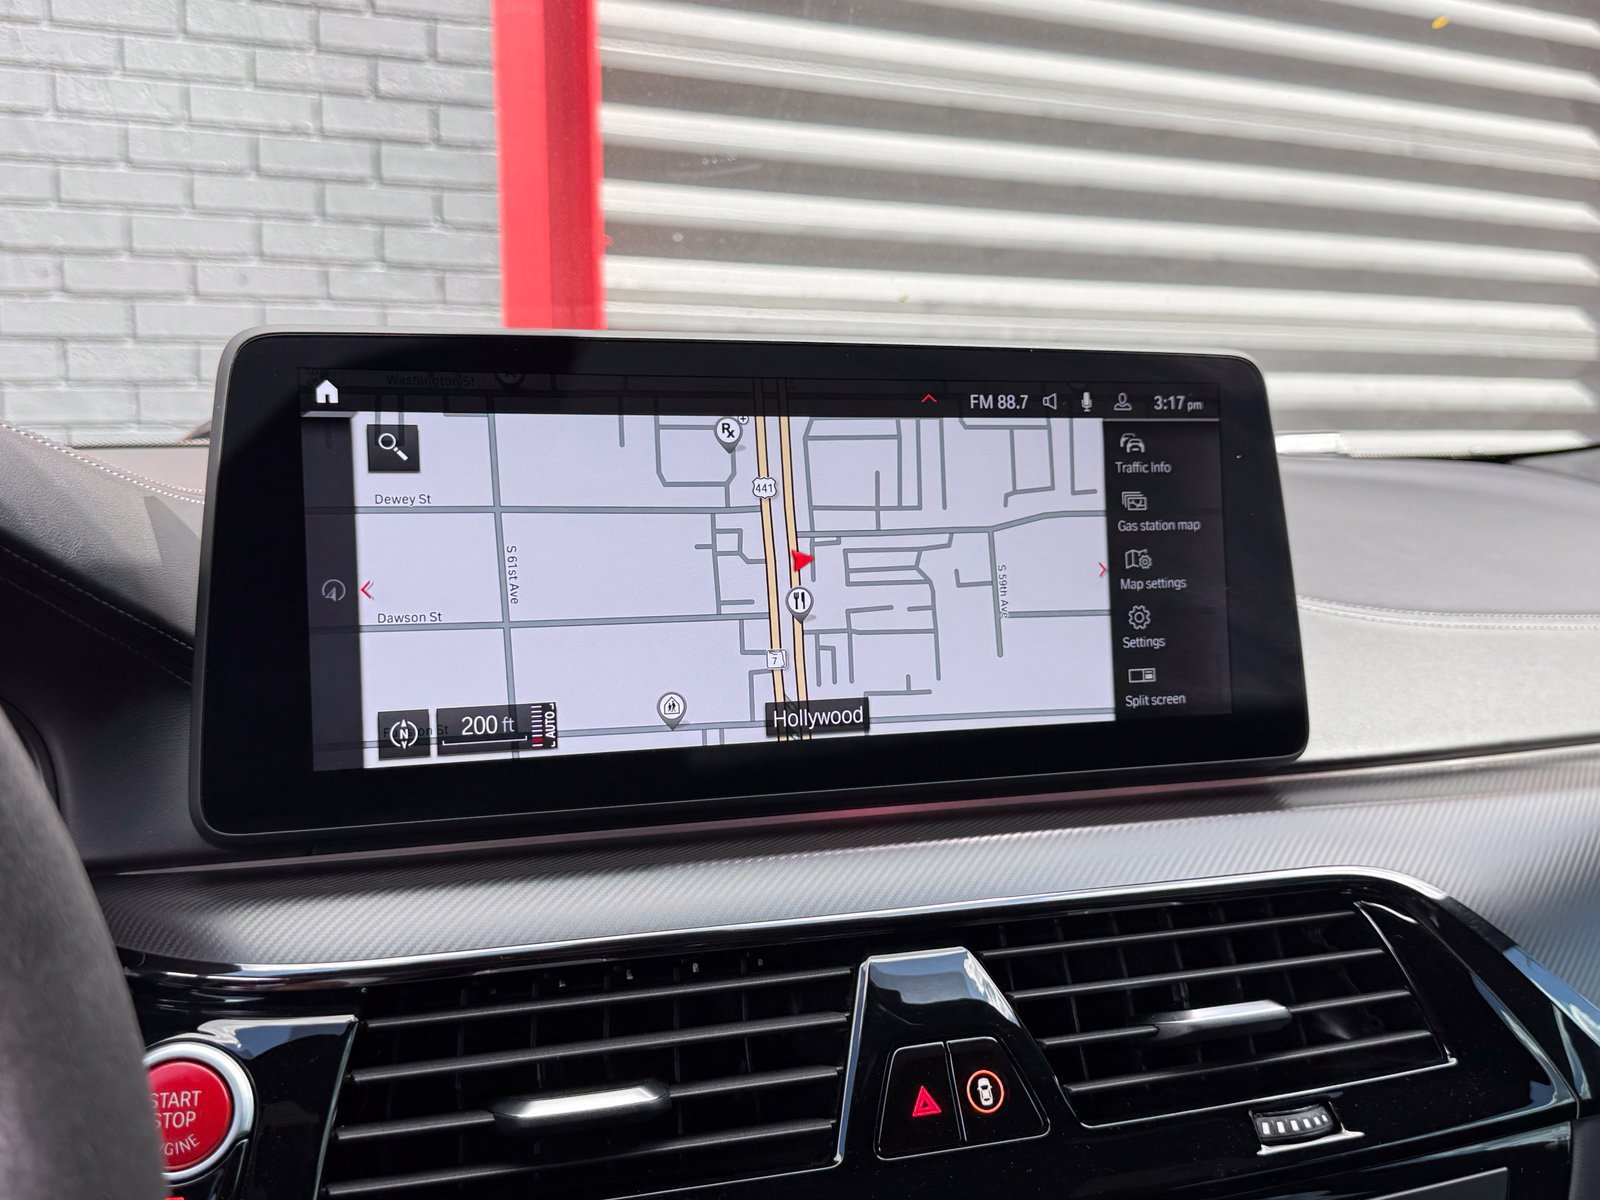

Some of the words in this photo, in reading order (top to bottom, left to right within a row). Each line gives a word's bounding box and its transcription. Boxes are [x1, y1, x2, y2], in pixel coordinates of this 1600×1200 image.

[969, 394, 993, 410] FM
[997, 394, 1029, 410] 88.7
[1153, 395, 1185, 410] 3:17
[1187, 401, 1204, 412] pm
[1115, 461, 1149, 474] Traffic
[1150, 461, 1172, 474] Info
[755, 483, 773, 493] 441
[374, 494, 416, 507] Dewey
[419, 493, 431, 505] St
[1117, 520, 1139, 532] Gas
[1141, 520, 1176, 532] station
[1178, 521, 1201, 534] map
[506, 545, 517, 553] S
[507, 556, 518, 581] 61st
[997, 564, 1007, 572] S
[998, 574, 1008, 597] 59th
[1120, 578, 1143, 591] Map
[1145, 577, 1188, 591] settings
[509, 583, 519, 605] Ave
[1000, 599, 1009, 619] Ave
[377, 612, 426, 623] Dawson
[429, 611, 442, 623] St
[1122, 636, 1166, 650] Settings
[771, 657, 778, 665] 7
[1125, 695, 1149, 708] Split
[1151, 694, 1186, 706] screen
[461, 715, 498, 735] 200
[501, 716, 515, 733] ft
[544, 711, 556, 739] AUTO
[773, 705, 864, 730] Hollywood
[400, 728, 409, 739] N
[152, 1090, 202, 1109] START
[155, 1111, 196, 1129] STOP
[162, 1133, 200, 1156] GINE
